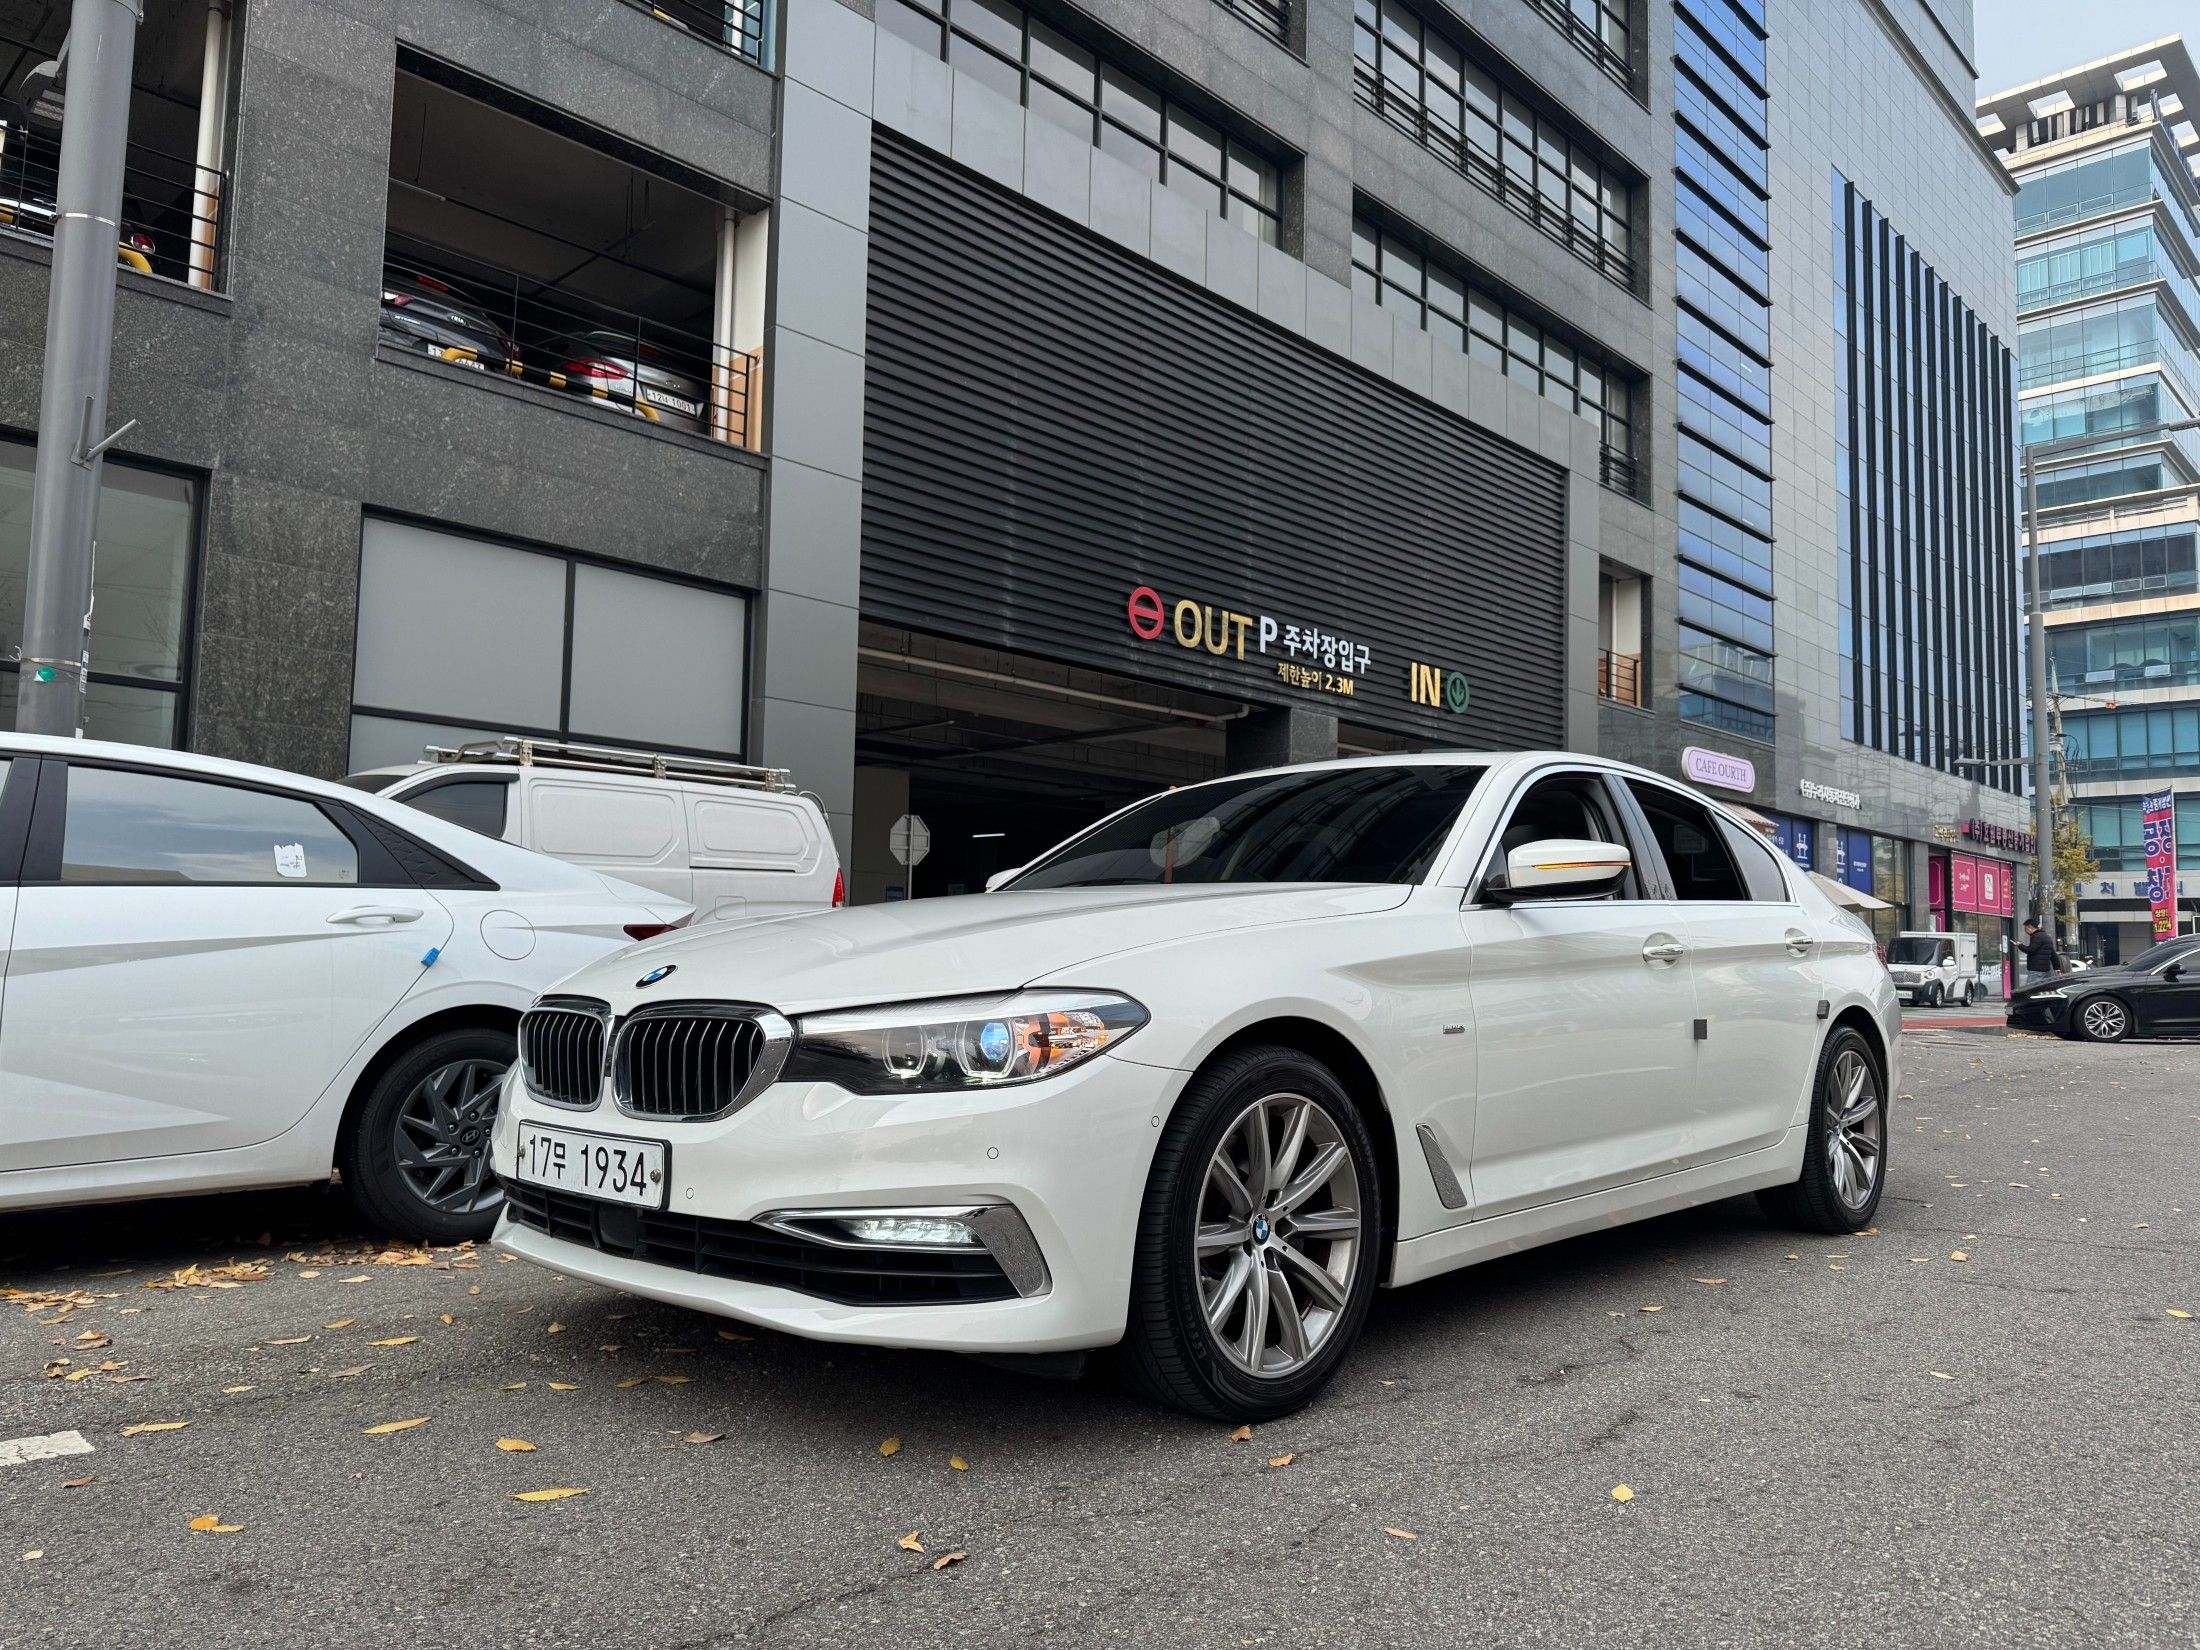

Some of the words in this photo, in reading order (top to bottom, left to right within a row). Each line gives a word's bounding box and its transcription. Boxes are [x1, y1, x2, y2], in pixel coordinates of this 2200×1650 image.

[1174, 599, 1253, 660] OUT
[1260, 615, 1278, 653] P
[1283, 624, 1371, 675] 주차장입구
[1278, 662, 1322, 690] 제한높이
[1325, 674, 1354, 696] 2.3M
[1410, 661, 1441, 708] IN
[1695, 757, 1717, 774] CAFE
[1717, 762, 1747, 782] OURTH
[529, 1134, 566, 1180] 17무
[580, 1143, 647, 1197] 1934
